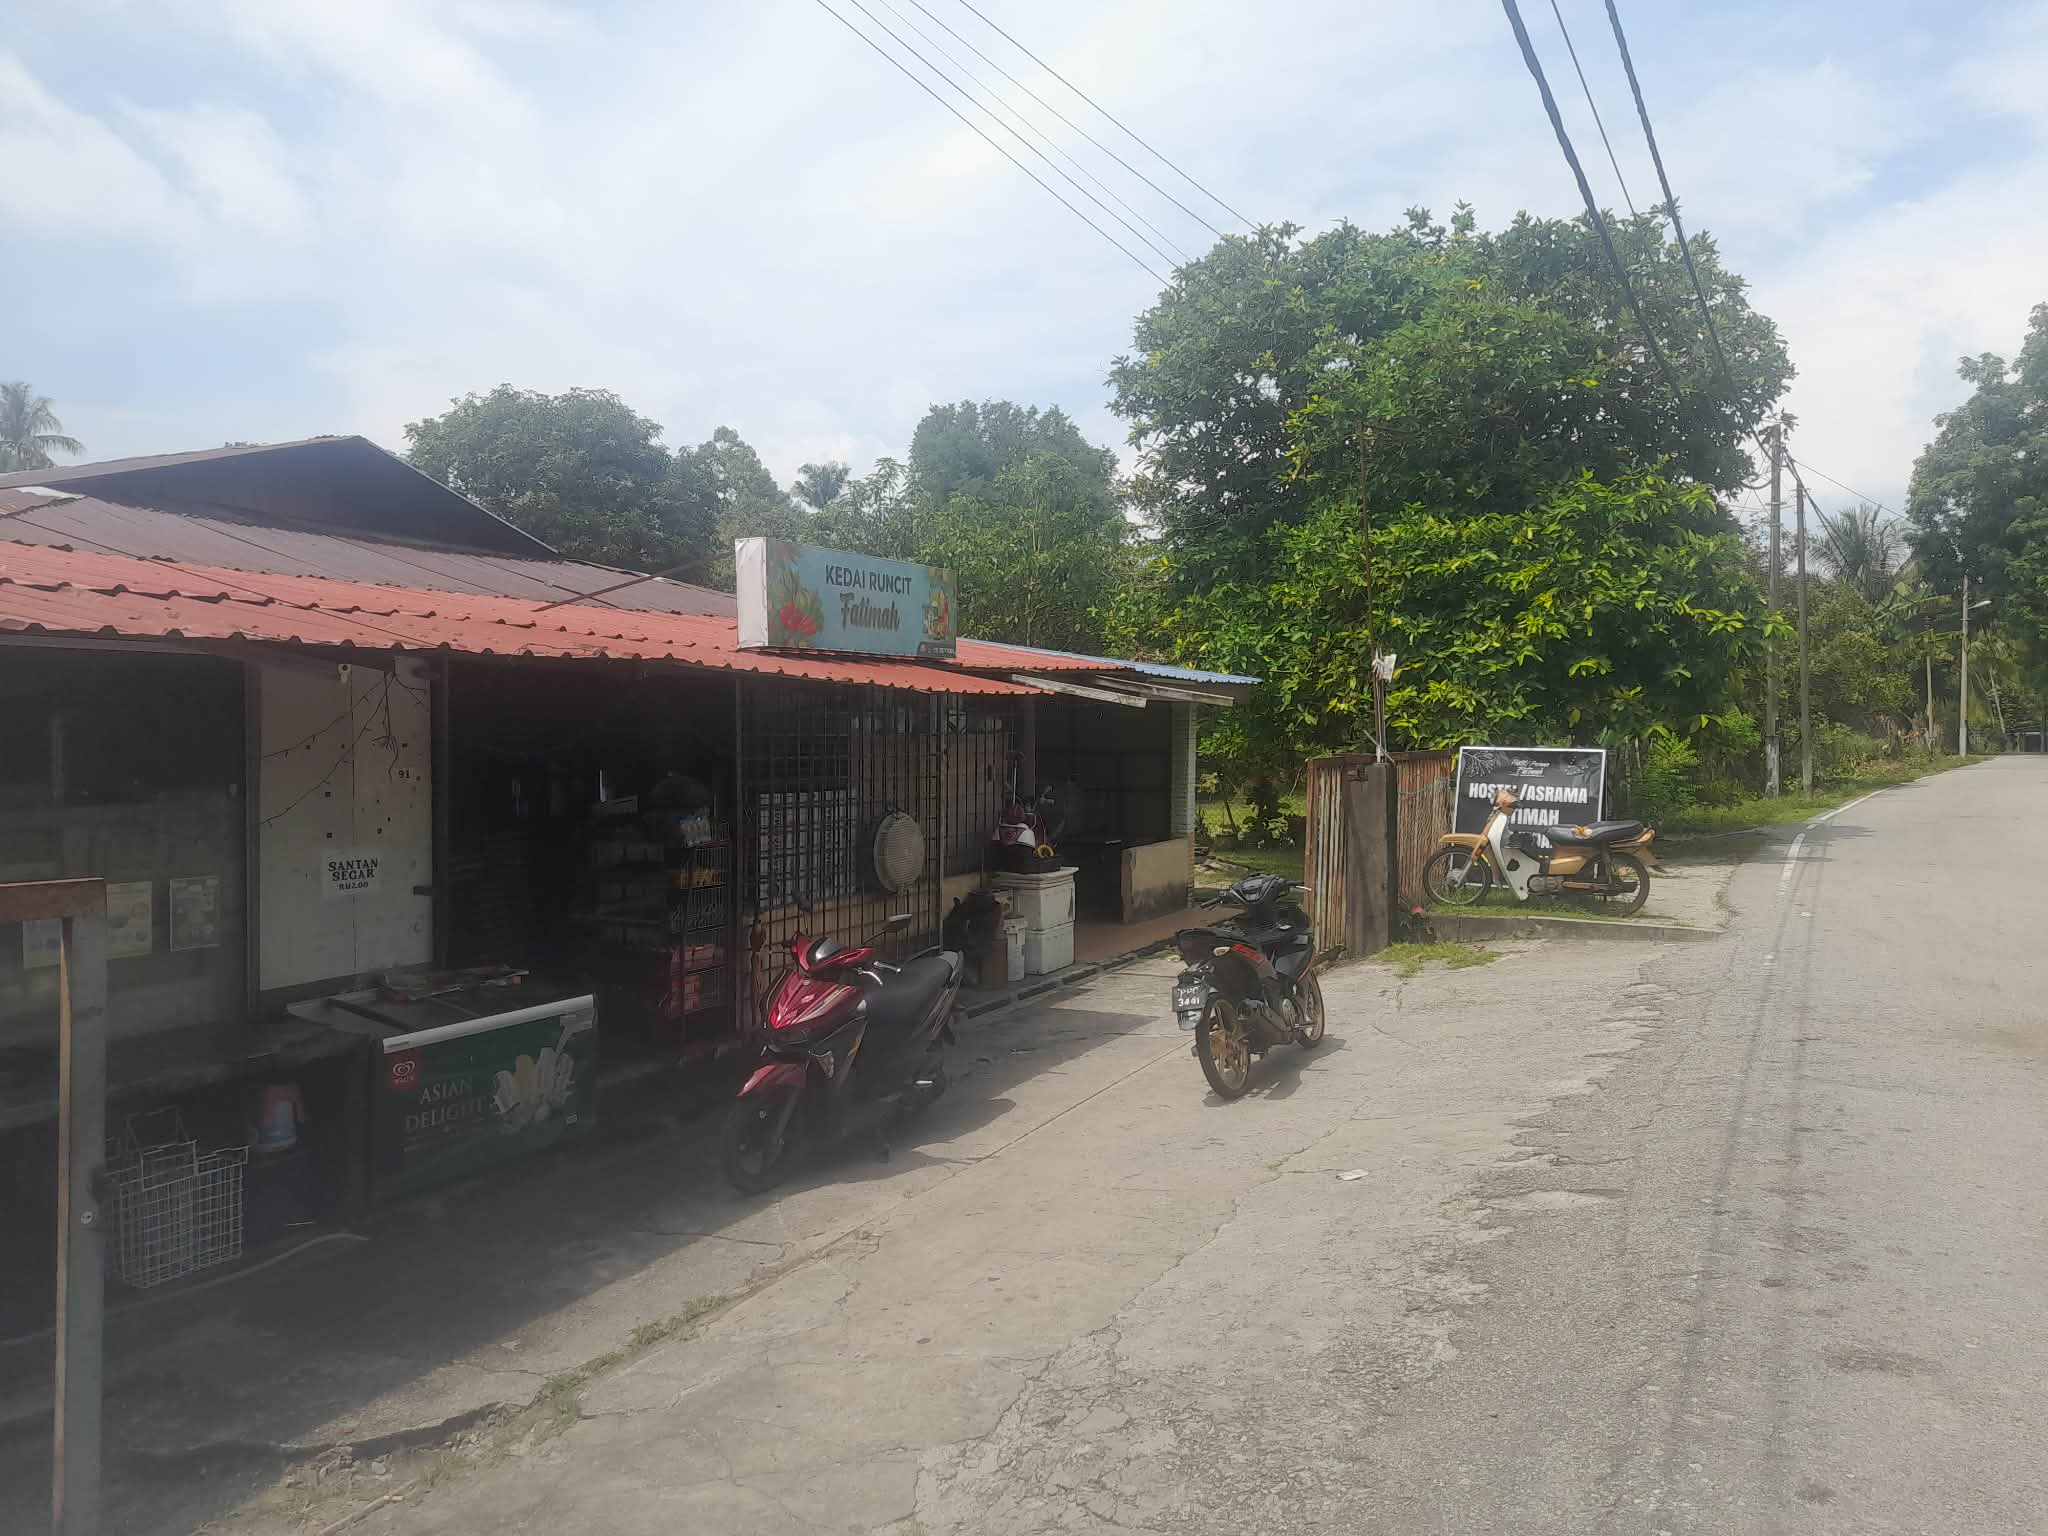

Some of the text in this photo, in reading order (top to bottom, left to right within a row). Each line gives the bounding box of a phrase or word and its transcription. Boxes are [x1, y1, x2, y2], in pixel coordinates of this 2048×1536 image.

[825, 564, 912, 595] KEDAI RUNCIT
[840, 592, 901, 632] Fatimah
[1510, 808, 1560, 826] TIMAH
[328, 858, 378, 872] SANTAN
[332, 869, 375, 881] SEGAR
